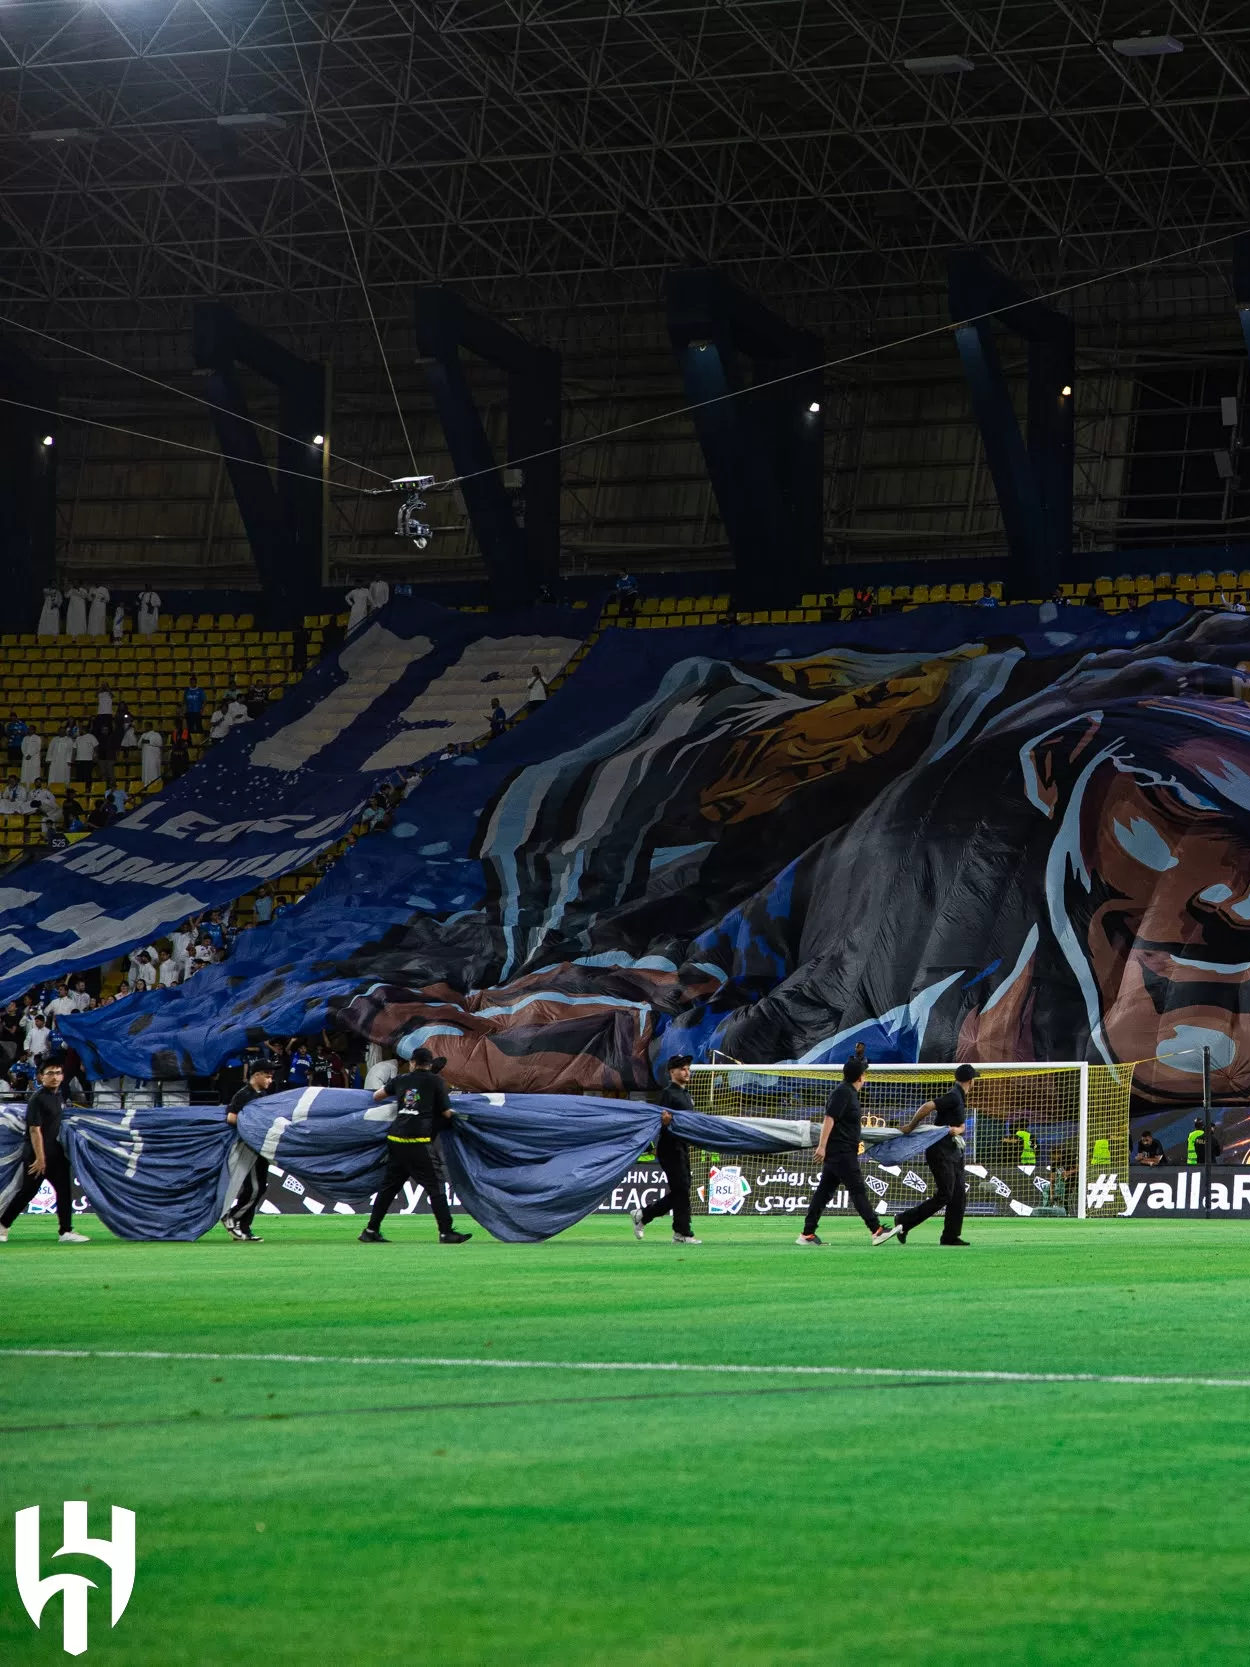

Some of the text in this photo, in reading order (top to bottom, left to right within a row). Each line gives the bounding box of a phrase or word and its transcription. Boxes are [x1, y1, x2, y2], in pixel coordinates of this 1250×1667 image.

[52, 838, 66, 848] S25
[757, 1166, 805, 1187] روشن
[715, 1185, 733, 1195] RSL
